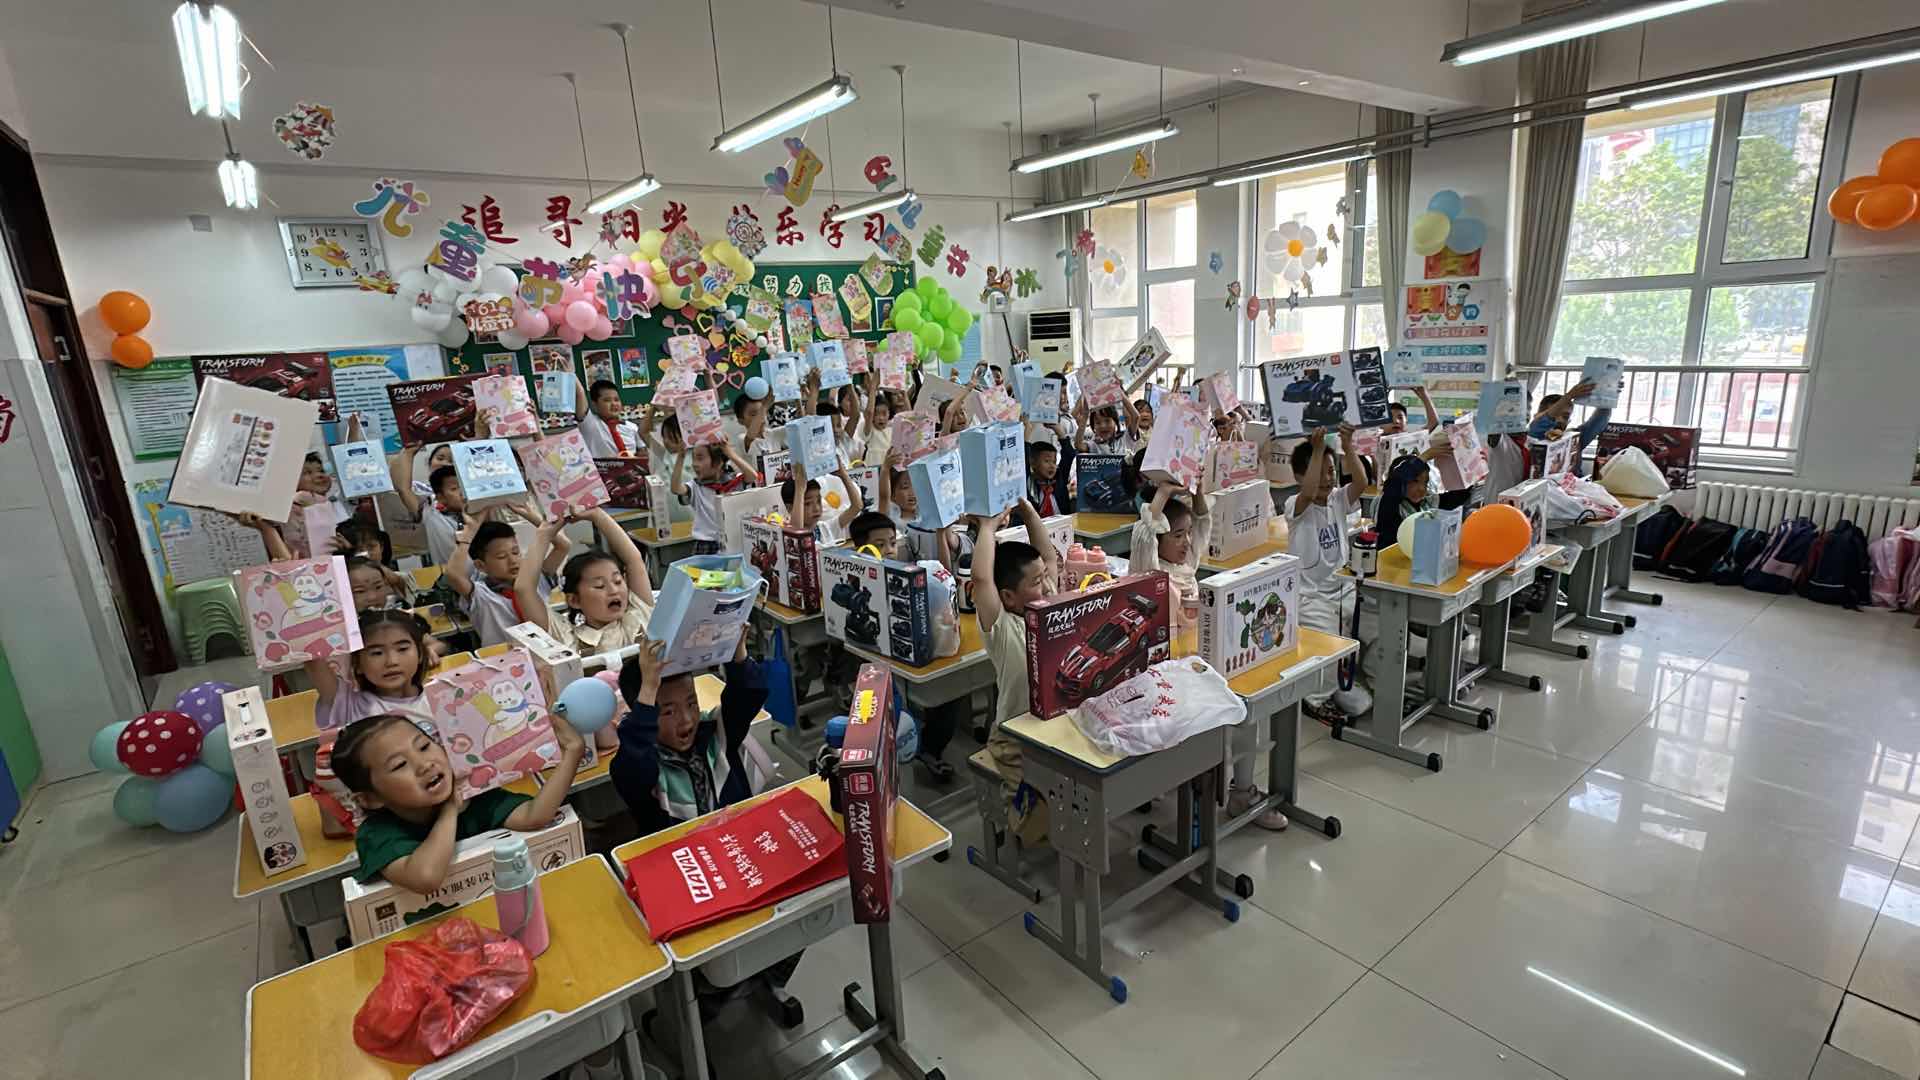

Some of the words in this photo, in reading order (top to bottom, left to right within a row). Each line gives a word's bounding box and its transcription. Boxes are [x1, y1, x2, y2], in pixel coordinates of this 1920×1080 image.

[297, 234, 307, 243] 10
[324, 228, 337, 237] 12
[301, 249, 309, 257] 9
[360, 248, 368, 256] 3
[304, 263, 312, 272] 8
[335, 268, 343, 277] 6
[199, 357, 267, 370] TRANSFORM
[1271, 357, 1327, 373] TRANSFORM
[392, 383, 446, 396] TRANSFORM
[823, 556, 866, 575] TRANSFORM
[1046, 594, 1113, 626] TRANSFORM
[856, 800, 877, 875] TRANSFORM
[675, 849, 711, 899] HAVAL
